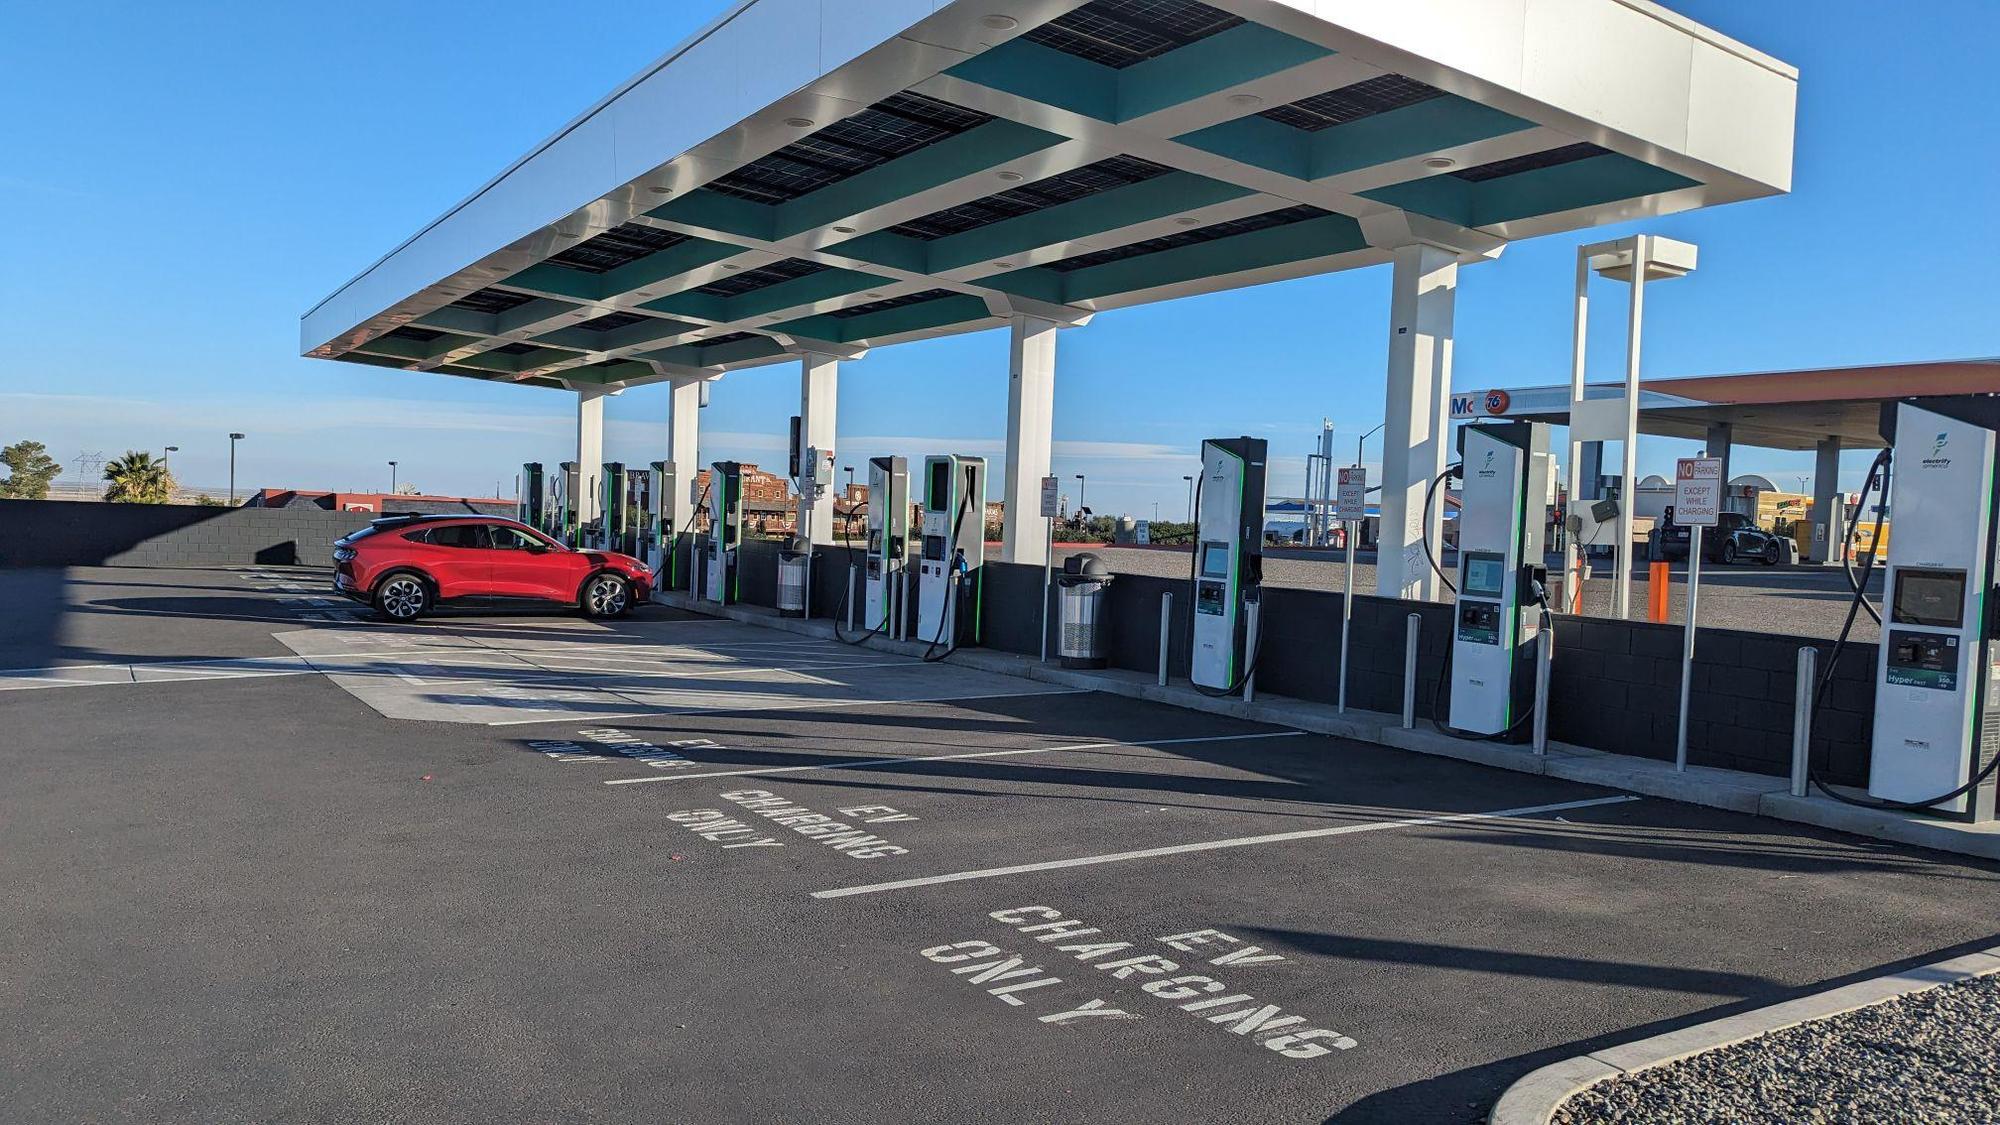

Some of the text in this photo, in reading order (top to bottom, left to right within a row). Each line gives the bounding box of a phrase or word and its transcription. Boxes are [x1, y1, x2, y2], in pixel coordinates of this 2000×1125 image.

[1486, 395, 1501, 409] 76
[1679, 463, 1719, 477] NO PARKING
[1684, 487, 1711, 495] EXCEPT
[1685, 497, 1707, 506] WHILE
[1679, 507, 1714, 516] CHARGING
[1888, 674, 1914, 684] Hyper
[838, 804, 920, 824] EV
[666, 808, 785, 850] ONLY
[719, 789, 910, 860] CHARGING
[1159, 928, 1286, 966] EV
[920, 939, 1132, 1025] ONLY
[988, 905, 1358, 1059] CHARGING
